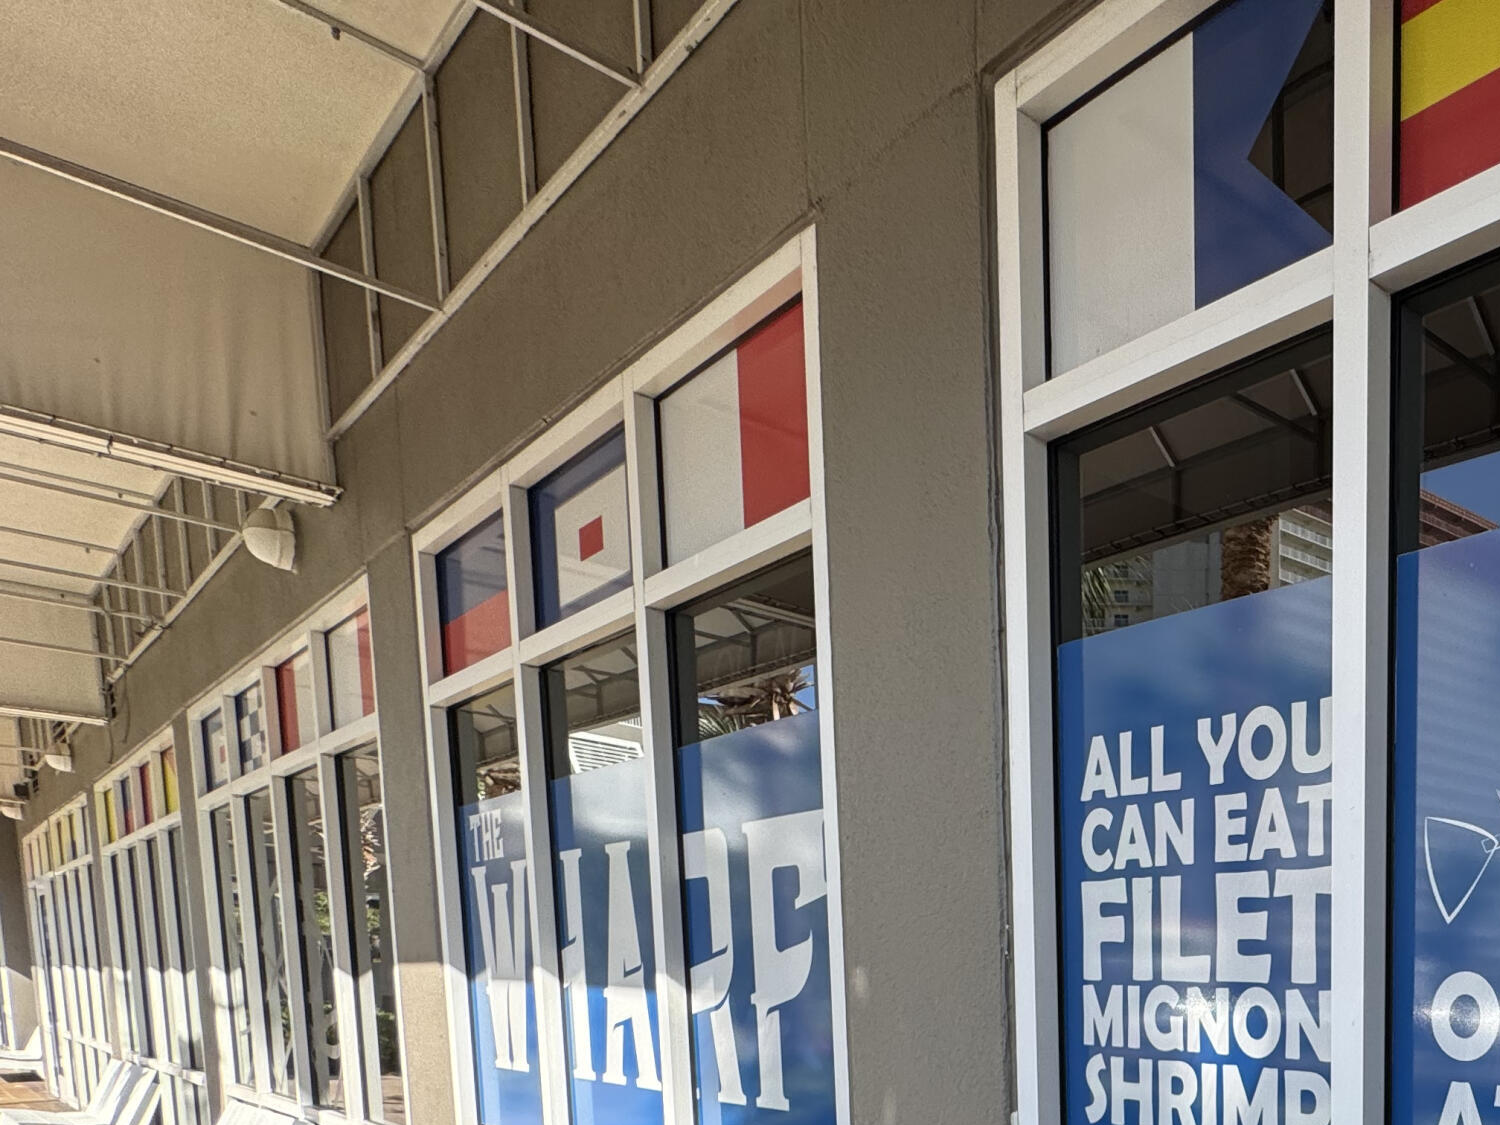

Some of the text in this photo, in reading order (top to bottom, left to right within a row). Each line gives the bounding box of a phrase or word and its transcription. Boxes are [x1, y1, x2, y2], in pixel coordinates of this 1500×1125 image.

[1081, 696, 1332, 801] ALL YOU
[469, 808, 504, 862] THE
[1081, 782, 1331, 872] CAN EAT
[1081, 866, 1332, 984] FILET
[1083, 984, 1331, 1062] MIGNON
